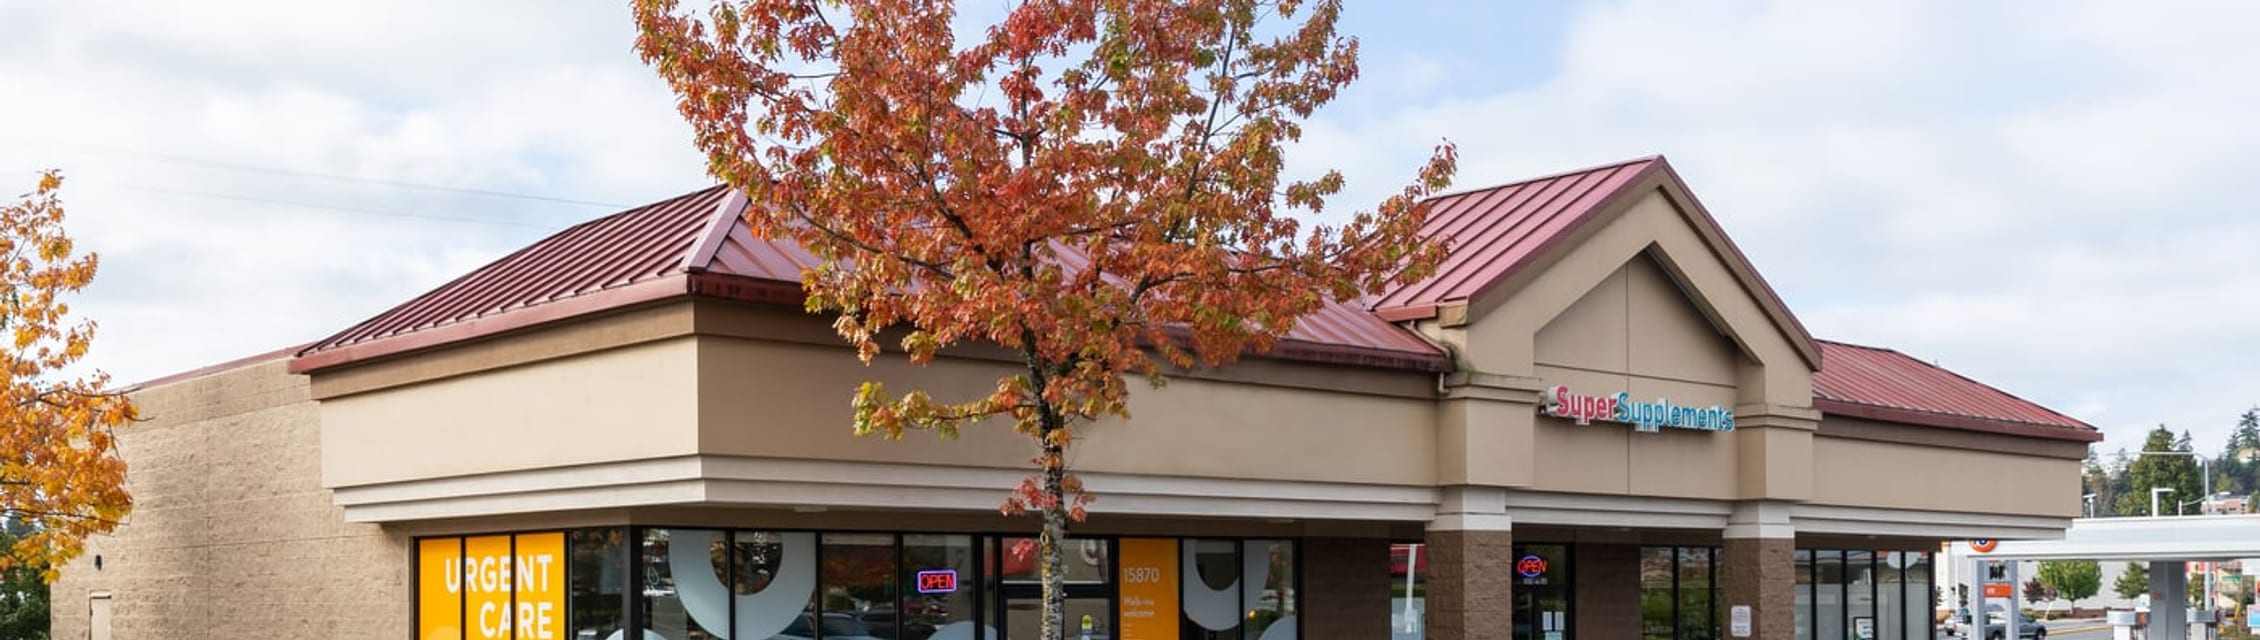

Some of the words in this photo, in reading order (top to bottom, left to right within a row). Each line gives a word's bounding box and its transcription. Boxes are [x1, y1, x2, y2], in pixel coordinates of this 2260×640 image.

[445, 554, 553, 594] URGENT
[1517, 559, 1548, 574] OPEN
[921, 574, 954, 589] OPEN
[479, 601, 553, 640] CARE
